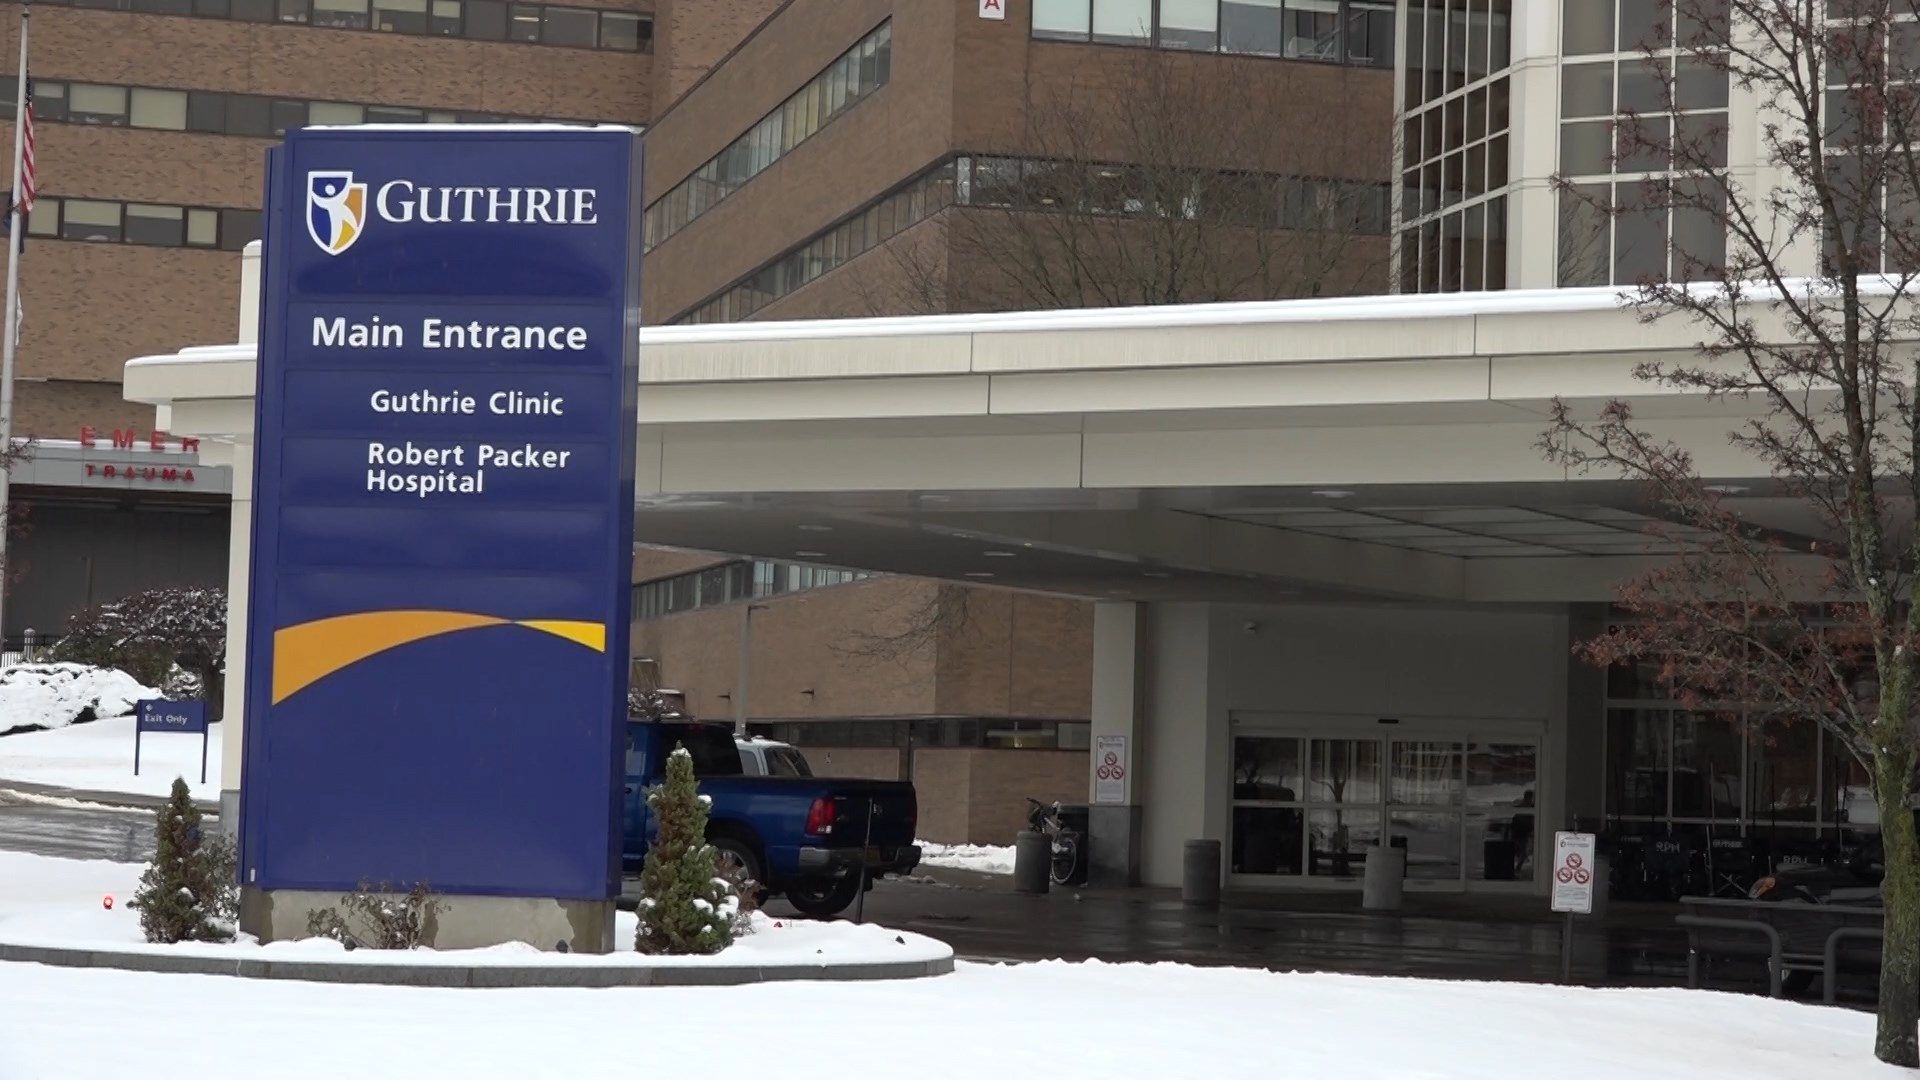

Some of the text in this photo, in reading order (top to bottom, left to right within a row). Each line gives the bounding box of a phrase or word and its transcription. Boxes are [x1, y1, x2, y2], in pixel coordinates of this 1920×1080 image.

[376, 179, 598, 224] GUTHRIE
[312, 315, 588, 350] Main Entrance
[370, 389, 565, 416] Guthrie Clinic
[368, 441, 571, 468] Robert Packer
[85, 463, 195, 482] TRAUMA
[367, 469, 484, 498] Hospital
[144, 713, 188, 726] Exit Only
